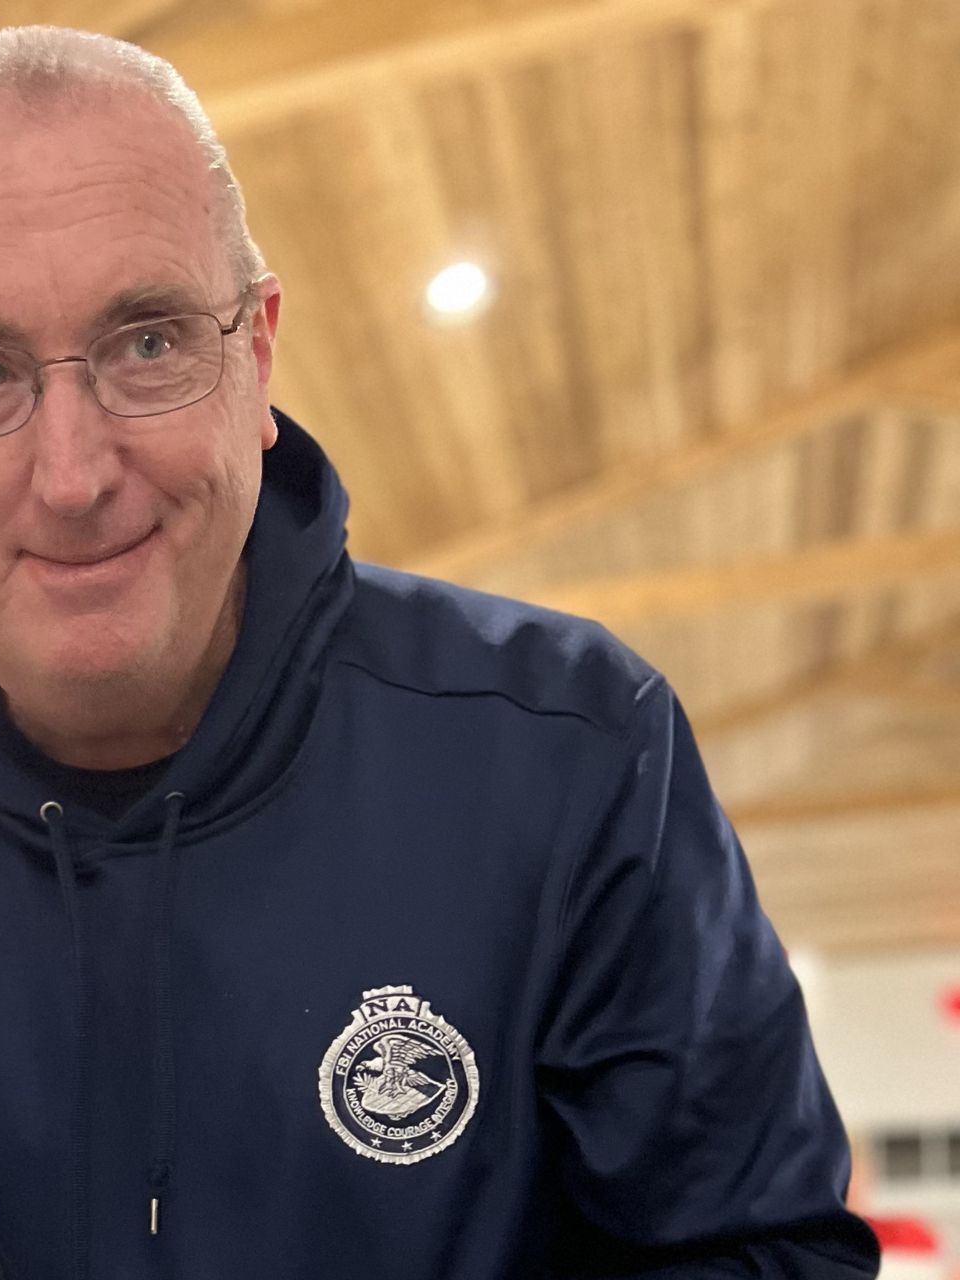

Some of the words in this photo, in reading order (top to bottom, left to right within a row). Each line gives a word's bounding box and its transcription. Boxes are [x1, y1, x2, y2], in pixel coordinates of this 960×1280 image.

[366, 998, 416, 1016] NA
[336, 1055, 351, 1076] FBI
[349, 1018, 407, 1056] NATIONAL
[410, 1019, 461, 1061] ACADEMY
[346, 1088, 389, 1135] KNOWLEDGE
[387, 1117, 433, 1138] COURAGE
